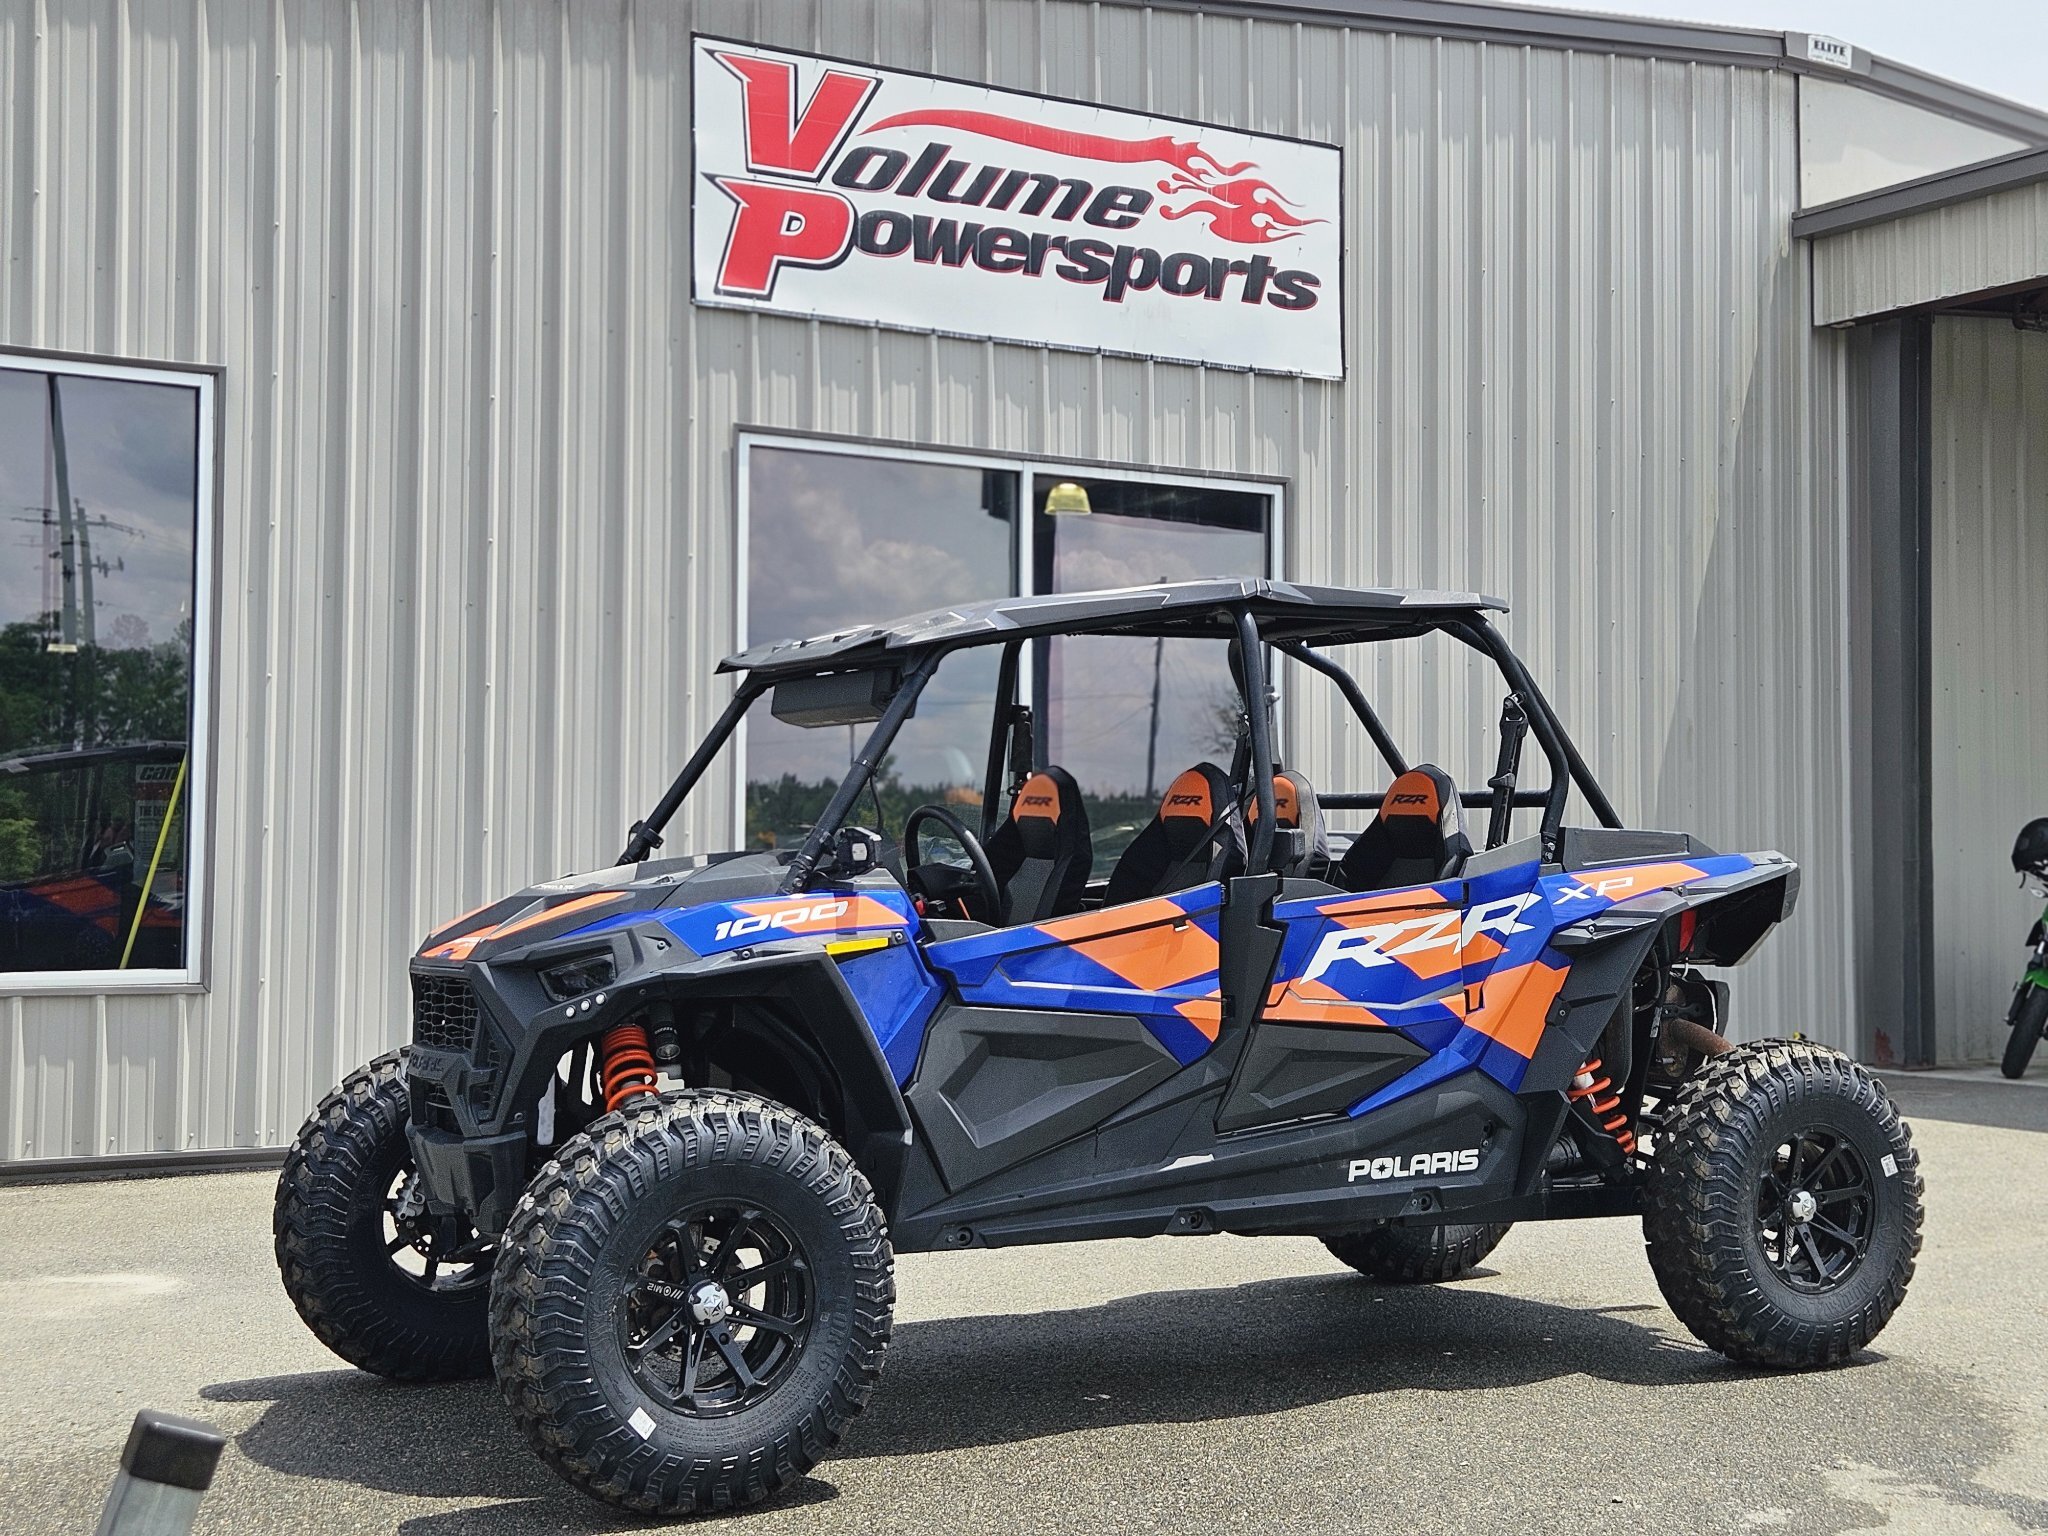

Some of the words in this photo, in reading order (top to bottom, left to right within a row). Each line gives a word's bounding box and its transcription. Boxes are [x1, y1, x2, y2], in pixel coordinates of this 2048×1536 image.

[1814, 40, 1846, 56] ELITE
[700, 46, 1155, 229] Volume
[700, 173, 1322, 310] Powersports
[1021, 796, 1053, 806] RZR
[1167, 795, 1203, 806] RZR
[1390, 794, 1429, 805] RZR
[1553, 876, 1633, 905] XP
[714, 900, 849, 941] 1000
[1299, 892, 1543, 984] RZR
[1348, 1149, 1479, 1182] POLARIS
